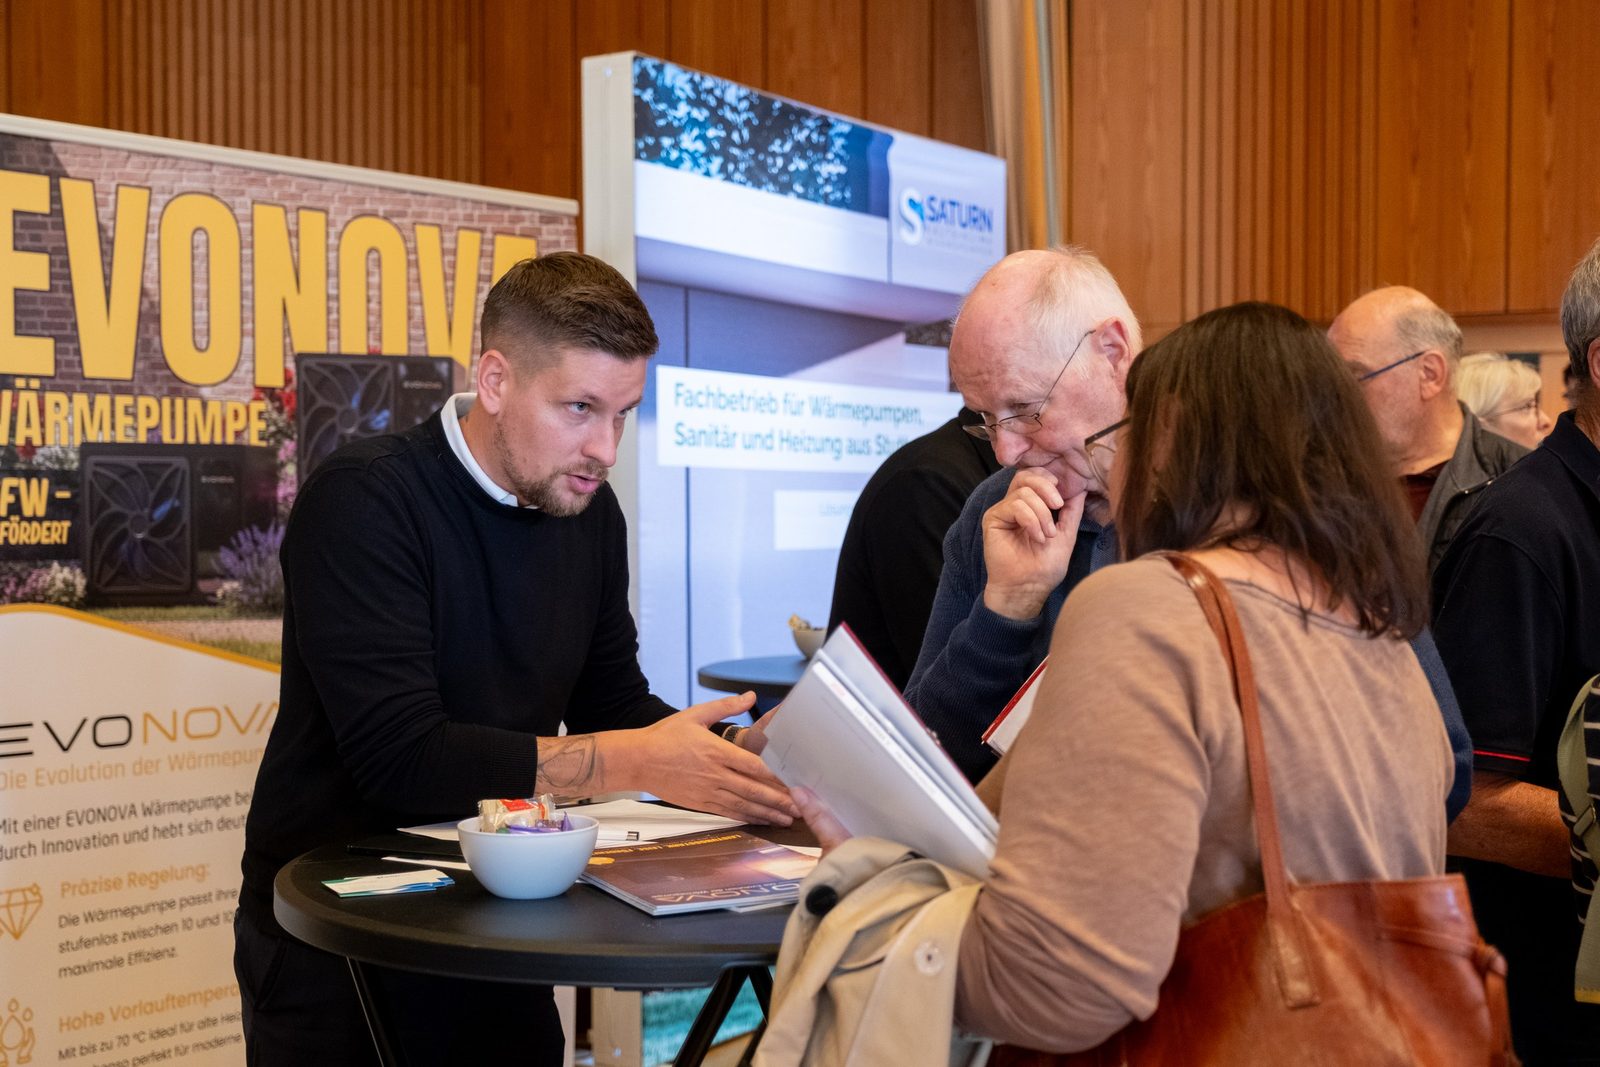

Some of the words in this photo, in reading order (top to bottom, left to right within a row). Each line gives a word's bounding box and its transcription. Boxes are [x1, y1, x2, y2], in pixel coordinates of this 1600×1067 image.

[926, 195, 993, 232] SATURN
[0, 169, 538, 388] EVONOV
[0, 378, 268, 447] ÄRMEPUMPE
[674, 382, 777, 414] Fachbetrieb
[783, 396, 805, 416] für
[809, 396, 923, 427] Wärmepumpen,
[674, 422, 736, 449] Sanitär
[742, 430, 774, 451] und
[779, 430, 843, 460] Heizung
[846, 438, 871, 456] aus
[35, 762, 126, 787] Evolution
[132, 755, 161, 776] der
[23, 814, 61, 833] einer
[66, 803, 138, 828] EVONOVA
[142, 792, 232, 817] Wärmepumpe
[42, 830, 119, 855] Innovation
[123, 824, 149, 844] und
[153, 821, 184, 840] hebt
[187, 817, 214, 835] sich
[59, 877, 123, 898] Präzise
[58, 913, 80, 929] Die
[84, 898, 176, 923] Wärmepumpe
[179, 890, 213, 911] passt
[58, 933, 119, 954] stufenlos
[121, 921, 178, 943] zwischen
[182, 917, 193, 932] 10
[196, 912, 221, 929] und
[58, 956, 125, 979] maximale
[58, 1011, 105, 1034] Hohe
[58, 1047, 76, 1061] Mit
[79, 1042, 98, 1057] bis
[100, 1039, 114, 1052] zu
[116, 1034, 130, 1048] 70
[149, 1024, 178, 1041] ideal
[179, 1020, 195, 1034] für
[174, 1043, 191, 1057] für
